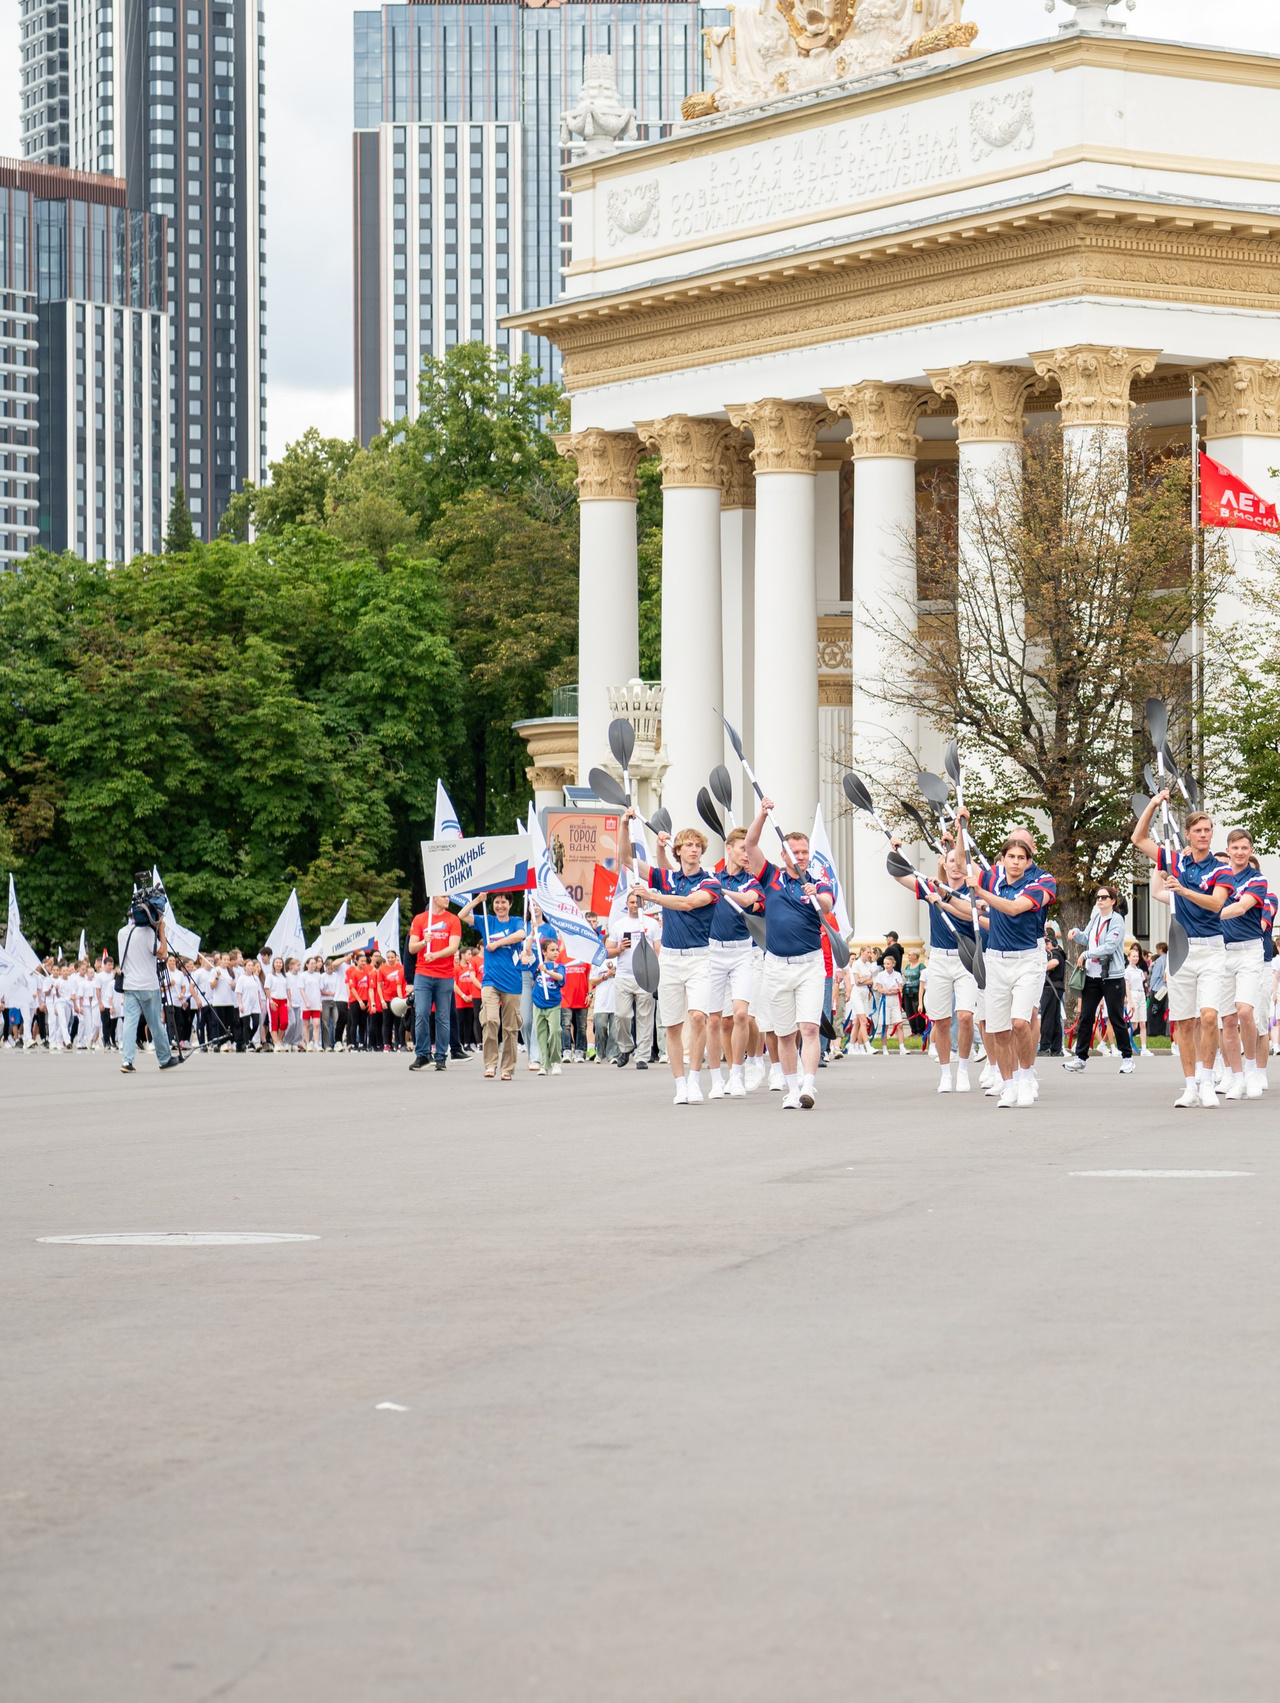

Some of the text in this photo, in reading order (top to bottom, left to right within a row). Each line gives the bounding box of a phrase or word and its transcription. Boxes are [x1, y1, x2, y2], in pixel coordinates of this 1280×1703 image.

[710, 112, 910, 182] РОССИЙСКАЯ
[671, 126, 958, 215] СОВЕТСКАЯ ФЕДЕРАТИВНАЯ
[671, 153, 961, 238] СОЦИАЛИСТИЧЕСКАЯ РЕСПУБЛИКА
[569, 829, 597, 844] ГОРОД
[569, 843, 597, 852] ВДНХ
[443, 842, 486, 878] ЛЫЖНЫЕ
[443, 865, 473, 892] ГОНКИ
[331, 927, 366, 954] ГИМНАСТИКА
